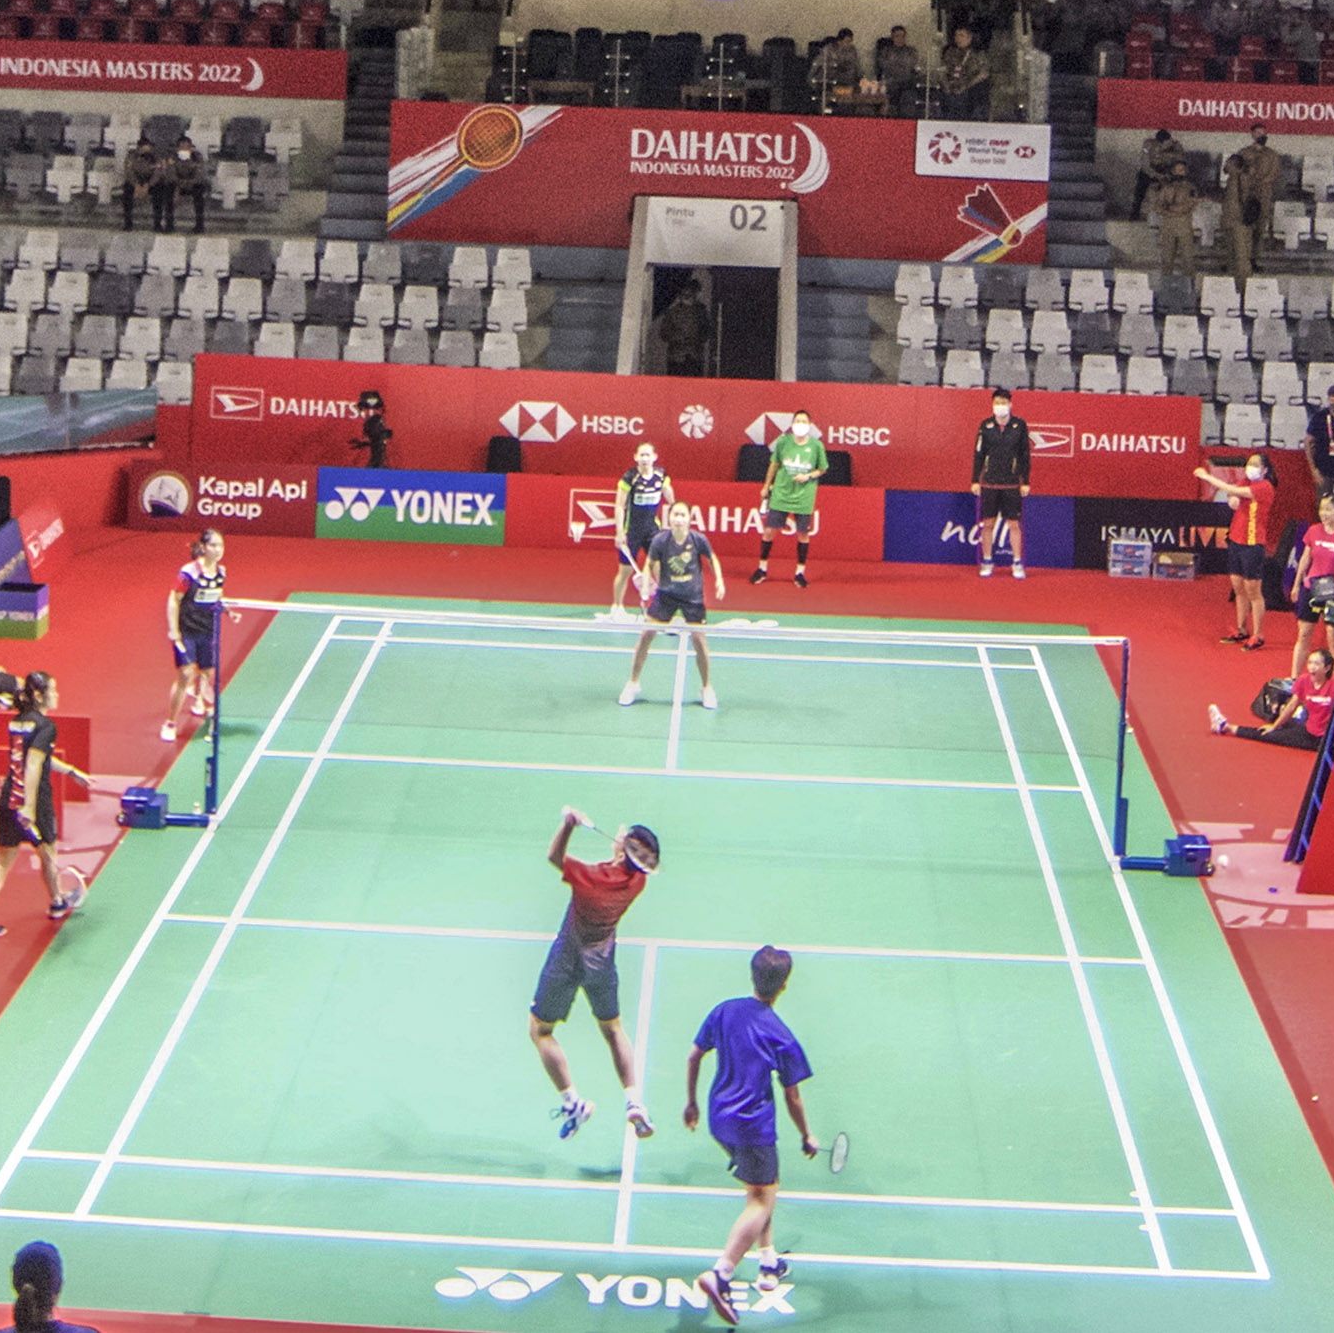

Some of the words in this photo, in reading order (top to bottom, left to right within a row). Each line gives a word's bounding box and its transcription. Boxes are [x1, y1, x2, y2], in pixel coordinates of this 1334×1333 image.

[0, 55, 101, 78] INDONESIA
[105, 59, 193, 82] MASTERS
[198, 64, 242, 83] 2022
[1178, 97, 1272, 120] DAIHATSU
[631, 127, 797, 165] DAIHATSU
[630, 161, 701, 176] INDONESIA
[703, 163, 764, 179] MASTERS
[766, 166, 796, 180] 2022
[729, 204, 767, 232] 02
[270, 396, 373, 420] DAIHATS
[581, 414, 644, 435] HSBC
[827, 425, 890, 446] HSBC
[1080, 432, 1186, 454] DAIHATSU
[197, 475, 263, 499] Kapal
[266, 479, 307, 501] Api
[196, 498, 263, 519] Group
[390, 489, 496, 526] YONEX
[1101, 525, 1175, 544] ISMAYA
[1179, 526, 1229, 548] LIVE
